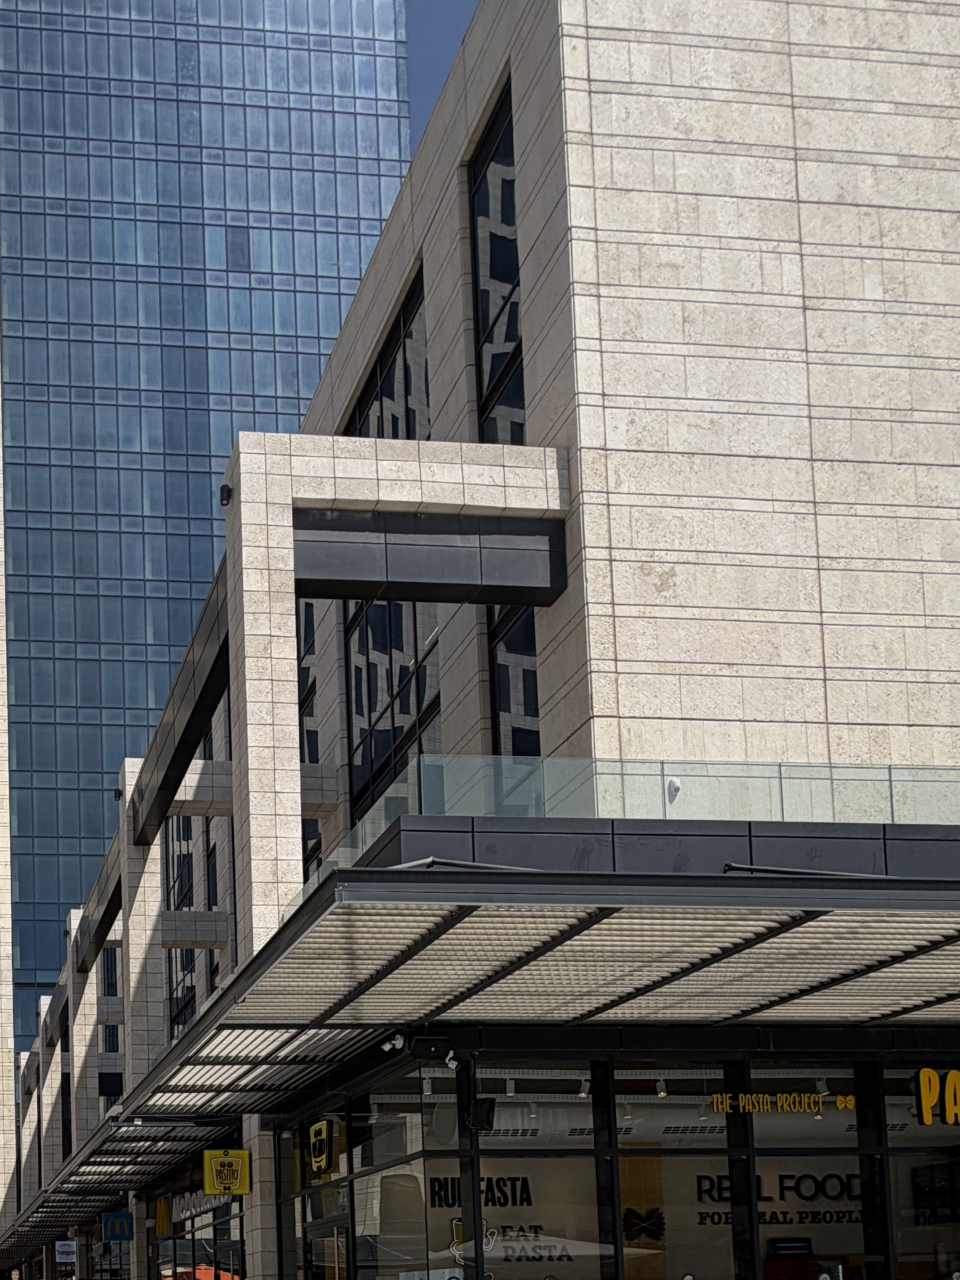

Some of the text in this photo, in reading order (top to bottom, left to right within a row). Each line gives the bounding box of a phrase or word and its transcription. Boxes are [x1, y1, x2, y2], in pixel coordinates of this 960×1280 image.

[712, 1093, 823, 1113] THE PASTA PROJECT
[696, 1173, 862, 1202] REL FOOD
[758, 1211, 793, 1225] EAL
[796, 1210, 863, 1225] PEOPL
[500, 1225, 543, 1241] EAT
[502, 1245, 574, 1262] PASTA
